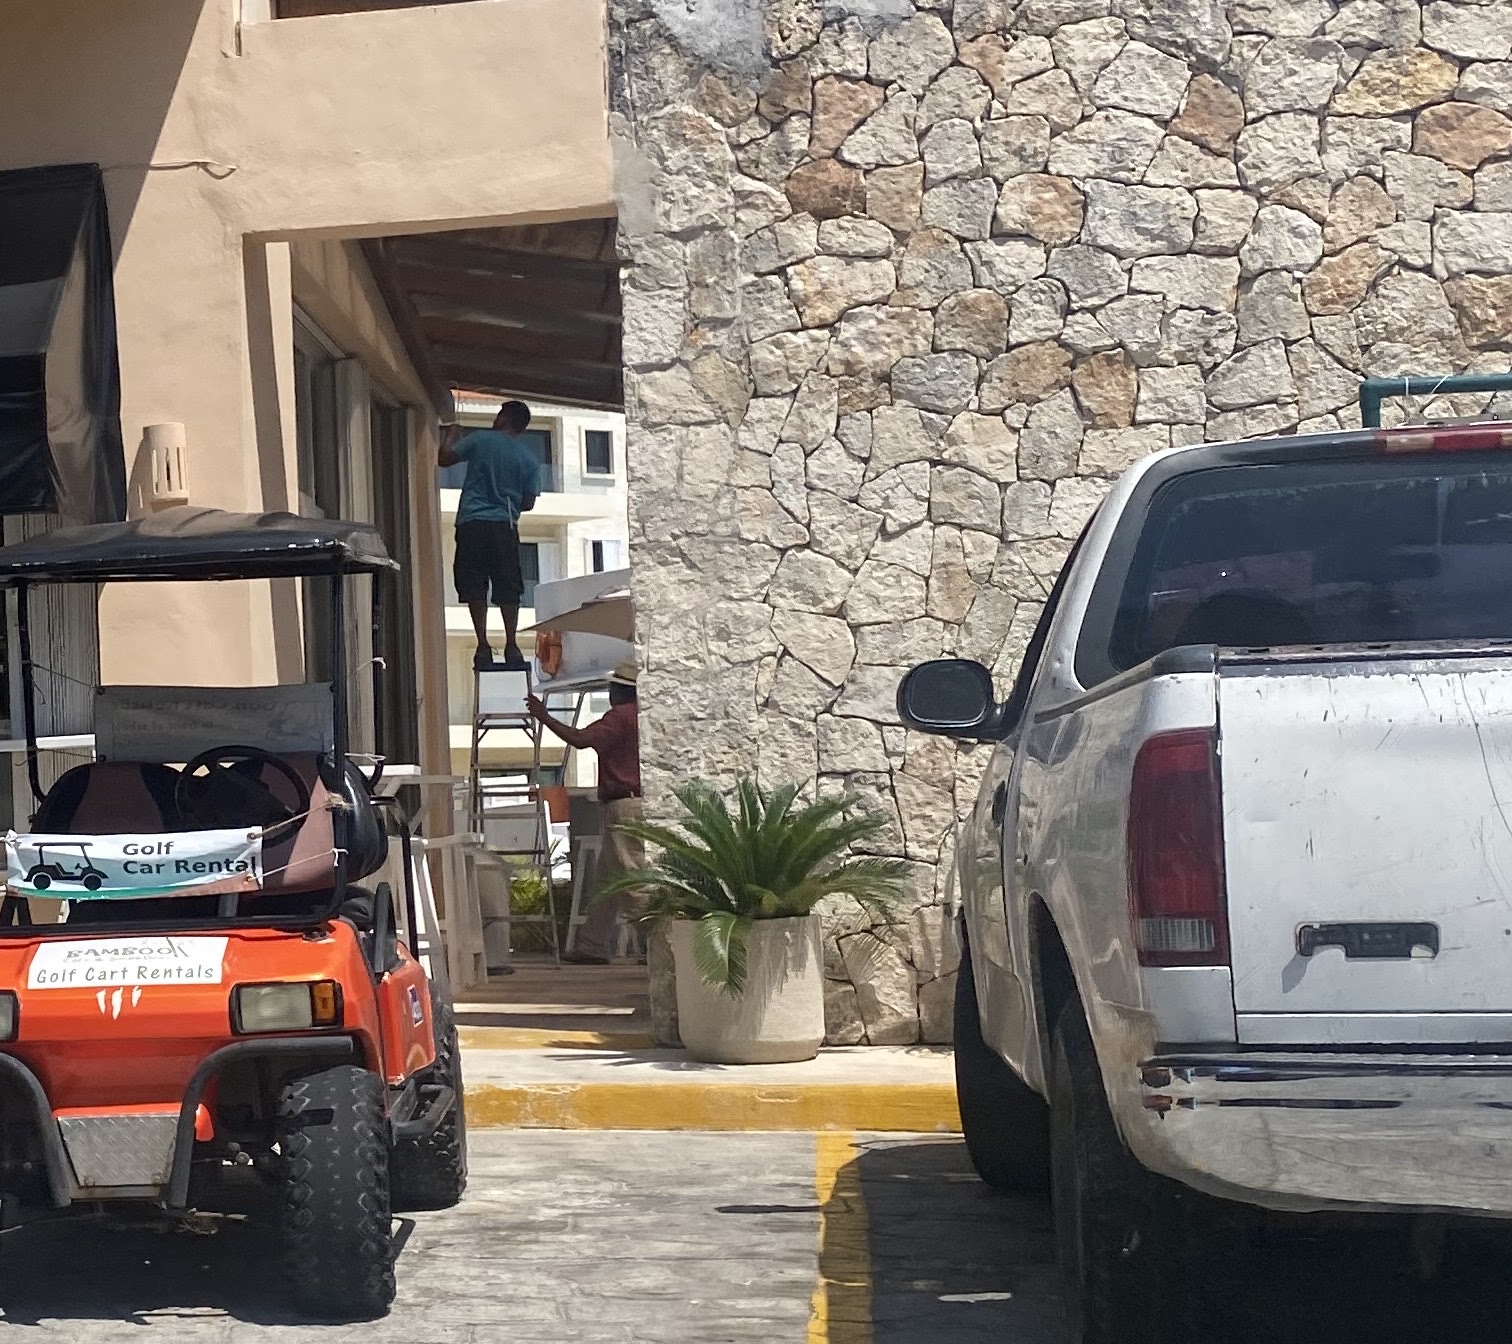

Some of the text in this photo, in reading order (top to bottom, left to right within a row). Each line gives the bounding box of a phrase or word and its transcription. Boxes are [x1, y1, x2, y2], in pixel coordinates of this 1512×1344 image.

[123, 841, 175, 855] Golf
[123, 856, 257, 876] Car Rental
[37, 964, 214, 983] Golf Cart Rentals
